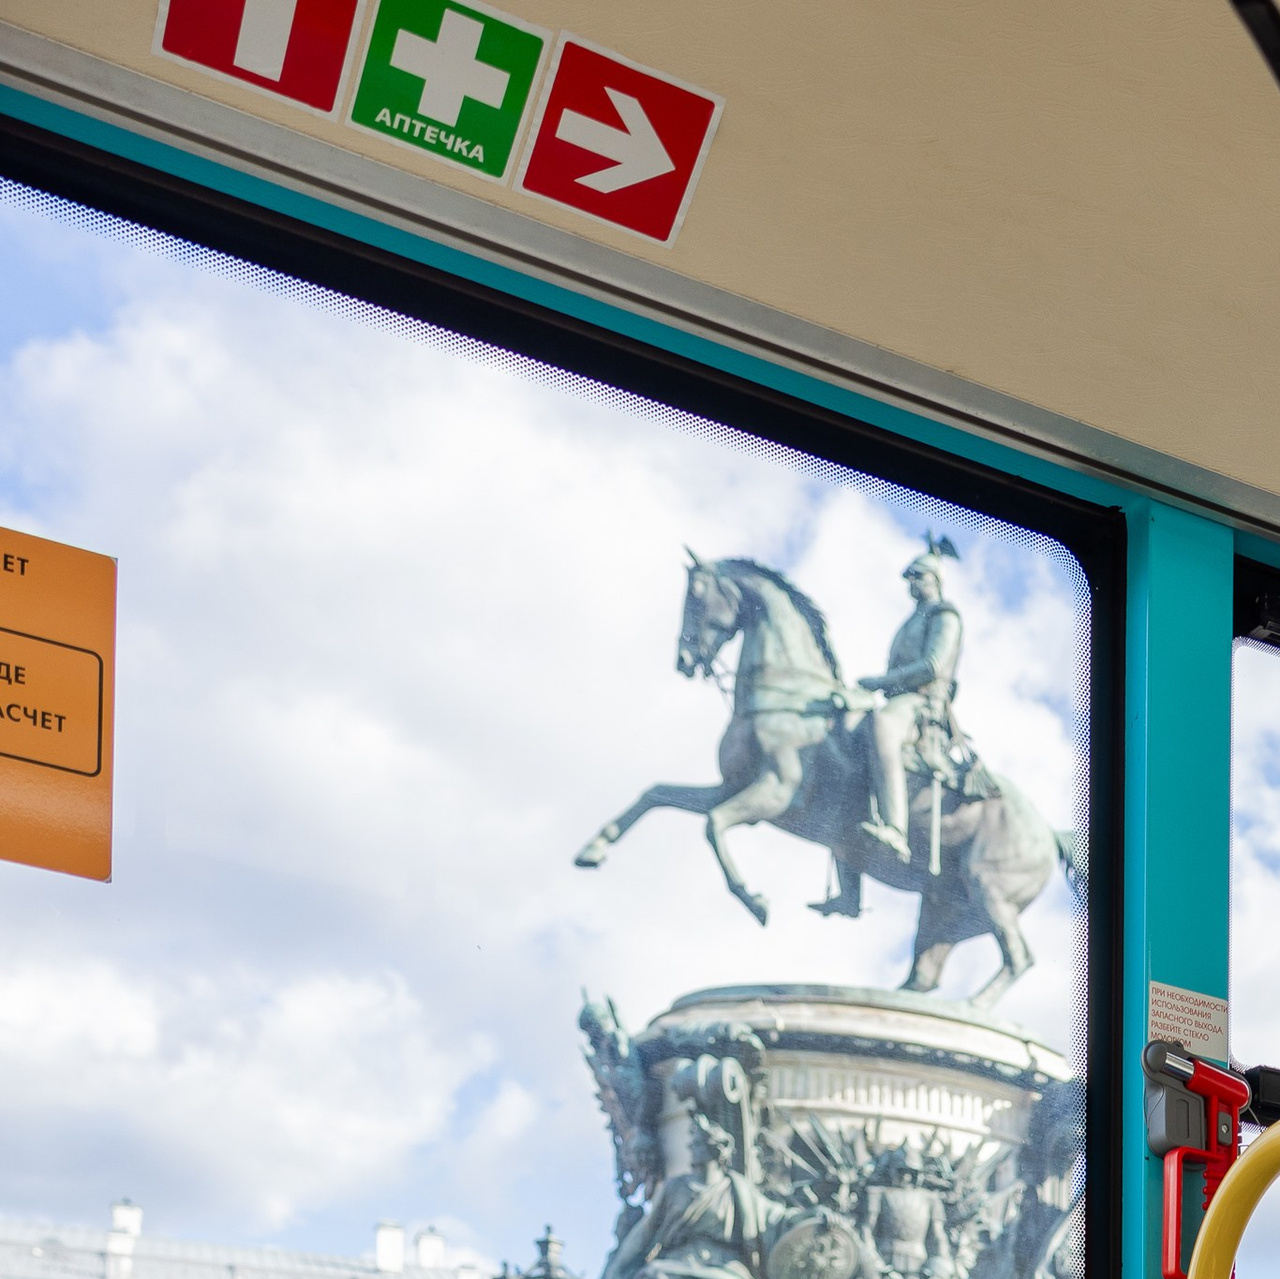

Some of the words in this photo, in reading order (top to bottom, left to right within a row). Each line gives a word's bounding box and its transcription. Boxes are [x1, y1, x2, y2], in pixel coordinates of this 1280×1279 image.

[374, 107, 484, 163] АПТЕЧКА
[1151, 986, 1166, 997] ПРИ
[1167, 992, 1228, 1014] НЕОБХОДИМОСТИ
[1151, 998, 1212, 1020] ИСПОЛЬЗОВАНИЯ
[1151, 1009, 1193, 1026] ЗАПАСНОГО
[1150, 1020, 1181, 1035] РАЗБЕЙТЕ
[1183, 1028, 1210, 1042] СТЕКЛО
